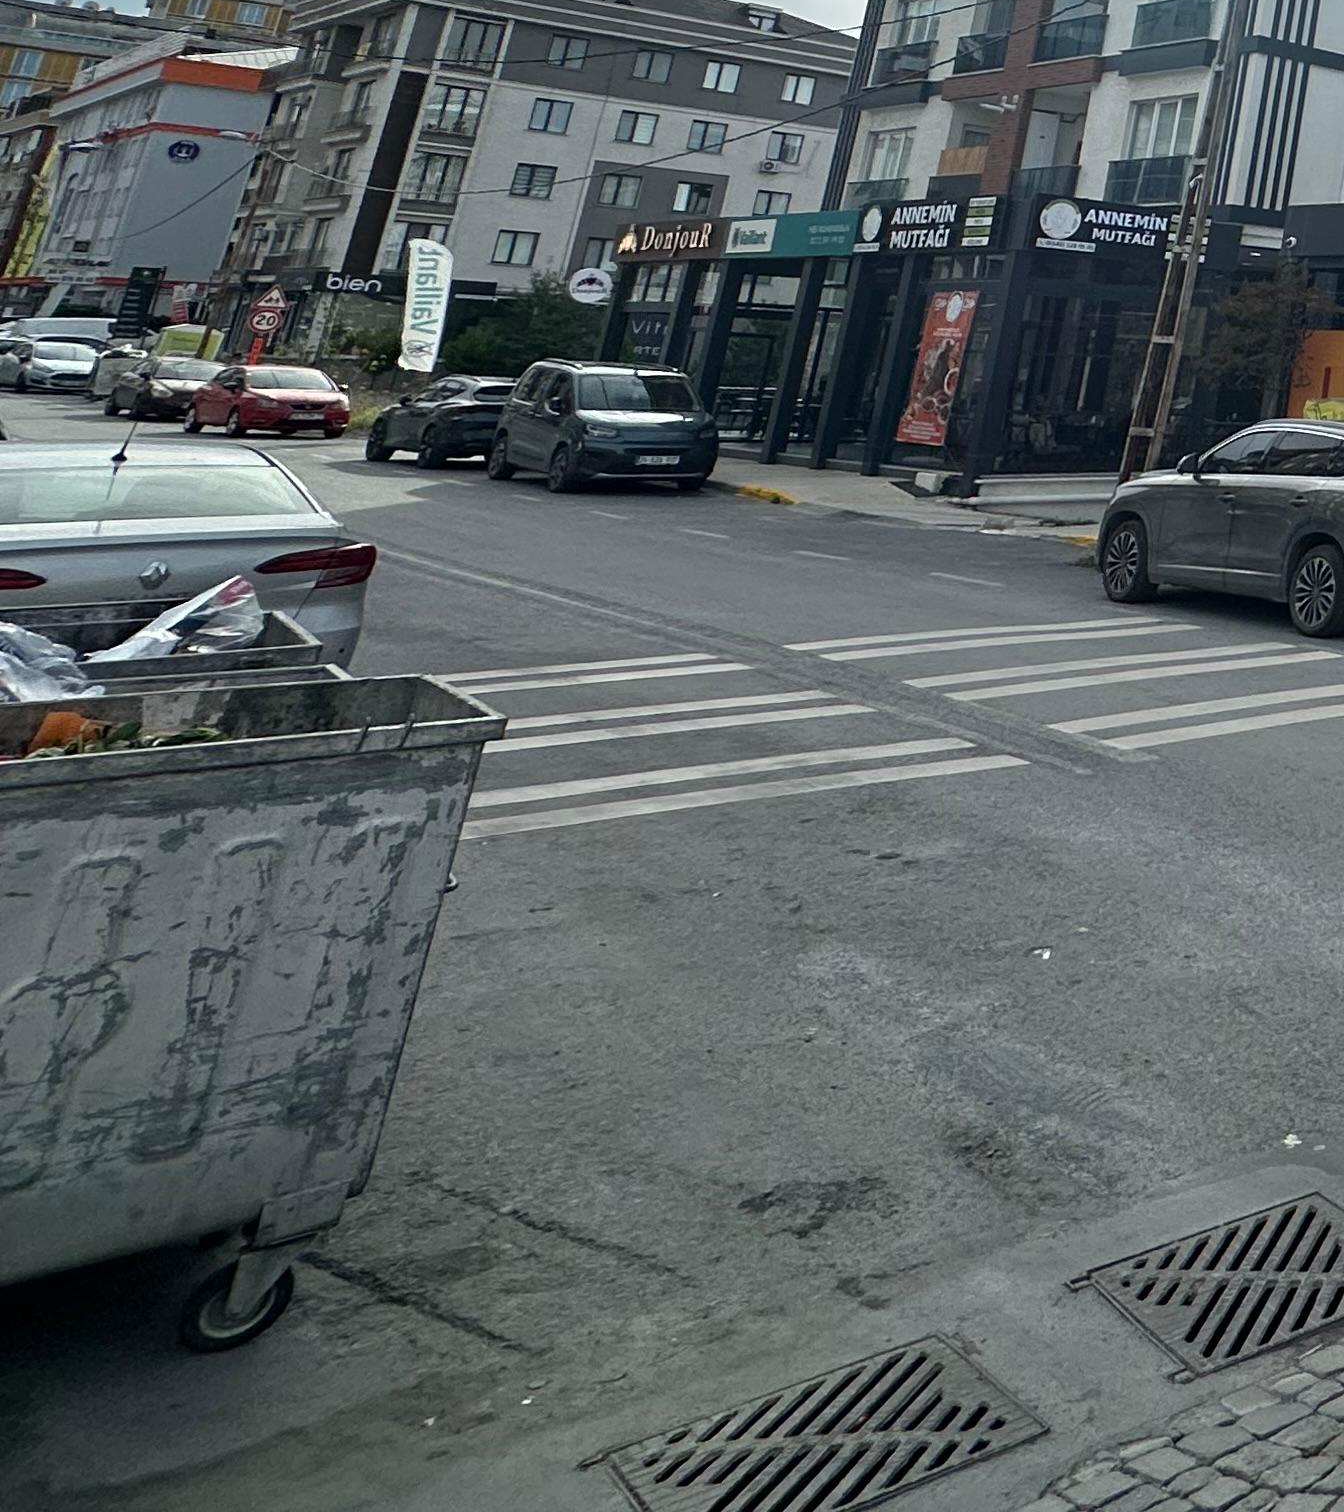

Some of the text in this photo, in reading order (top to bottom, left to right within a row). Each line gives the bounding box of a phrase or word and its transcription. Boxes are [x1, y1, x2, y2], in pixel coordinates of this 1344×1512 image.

[889, 224, 951, 249] MUTFAĞI
[1091, 228, 1156, 247] MUTFAĞI
[326, 273, 382, 293] bien
[257, 314, 276, 325] 20
